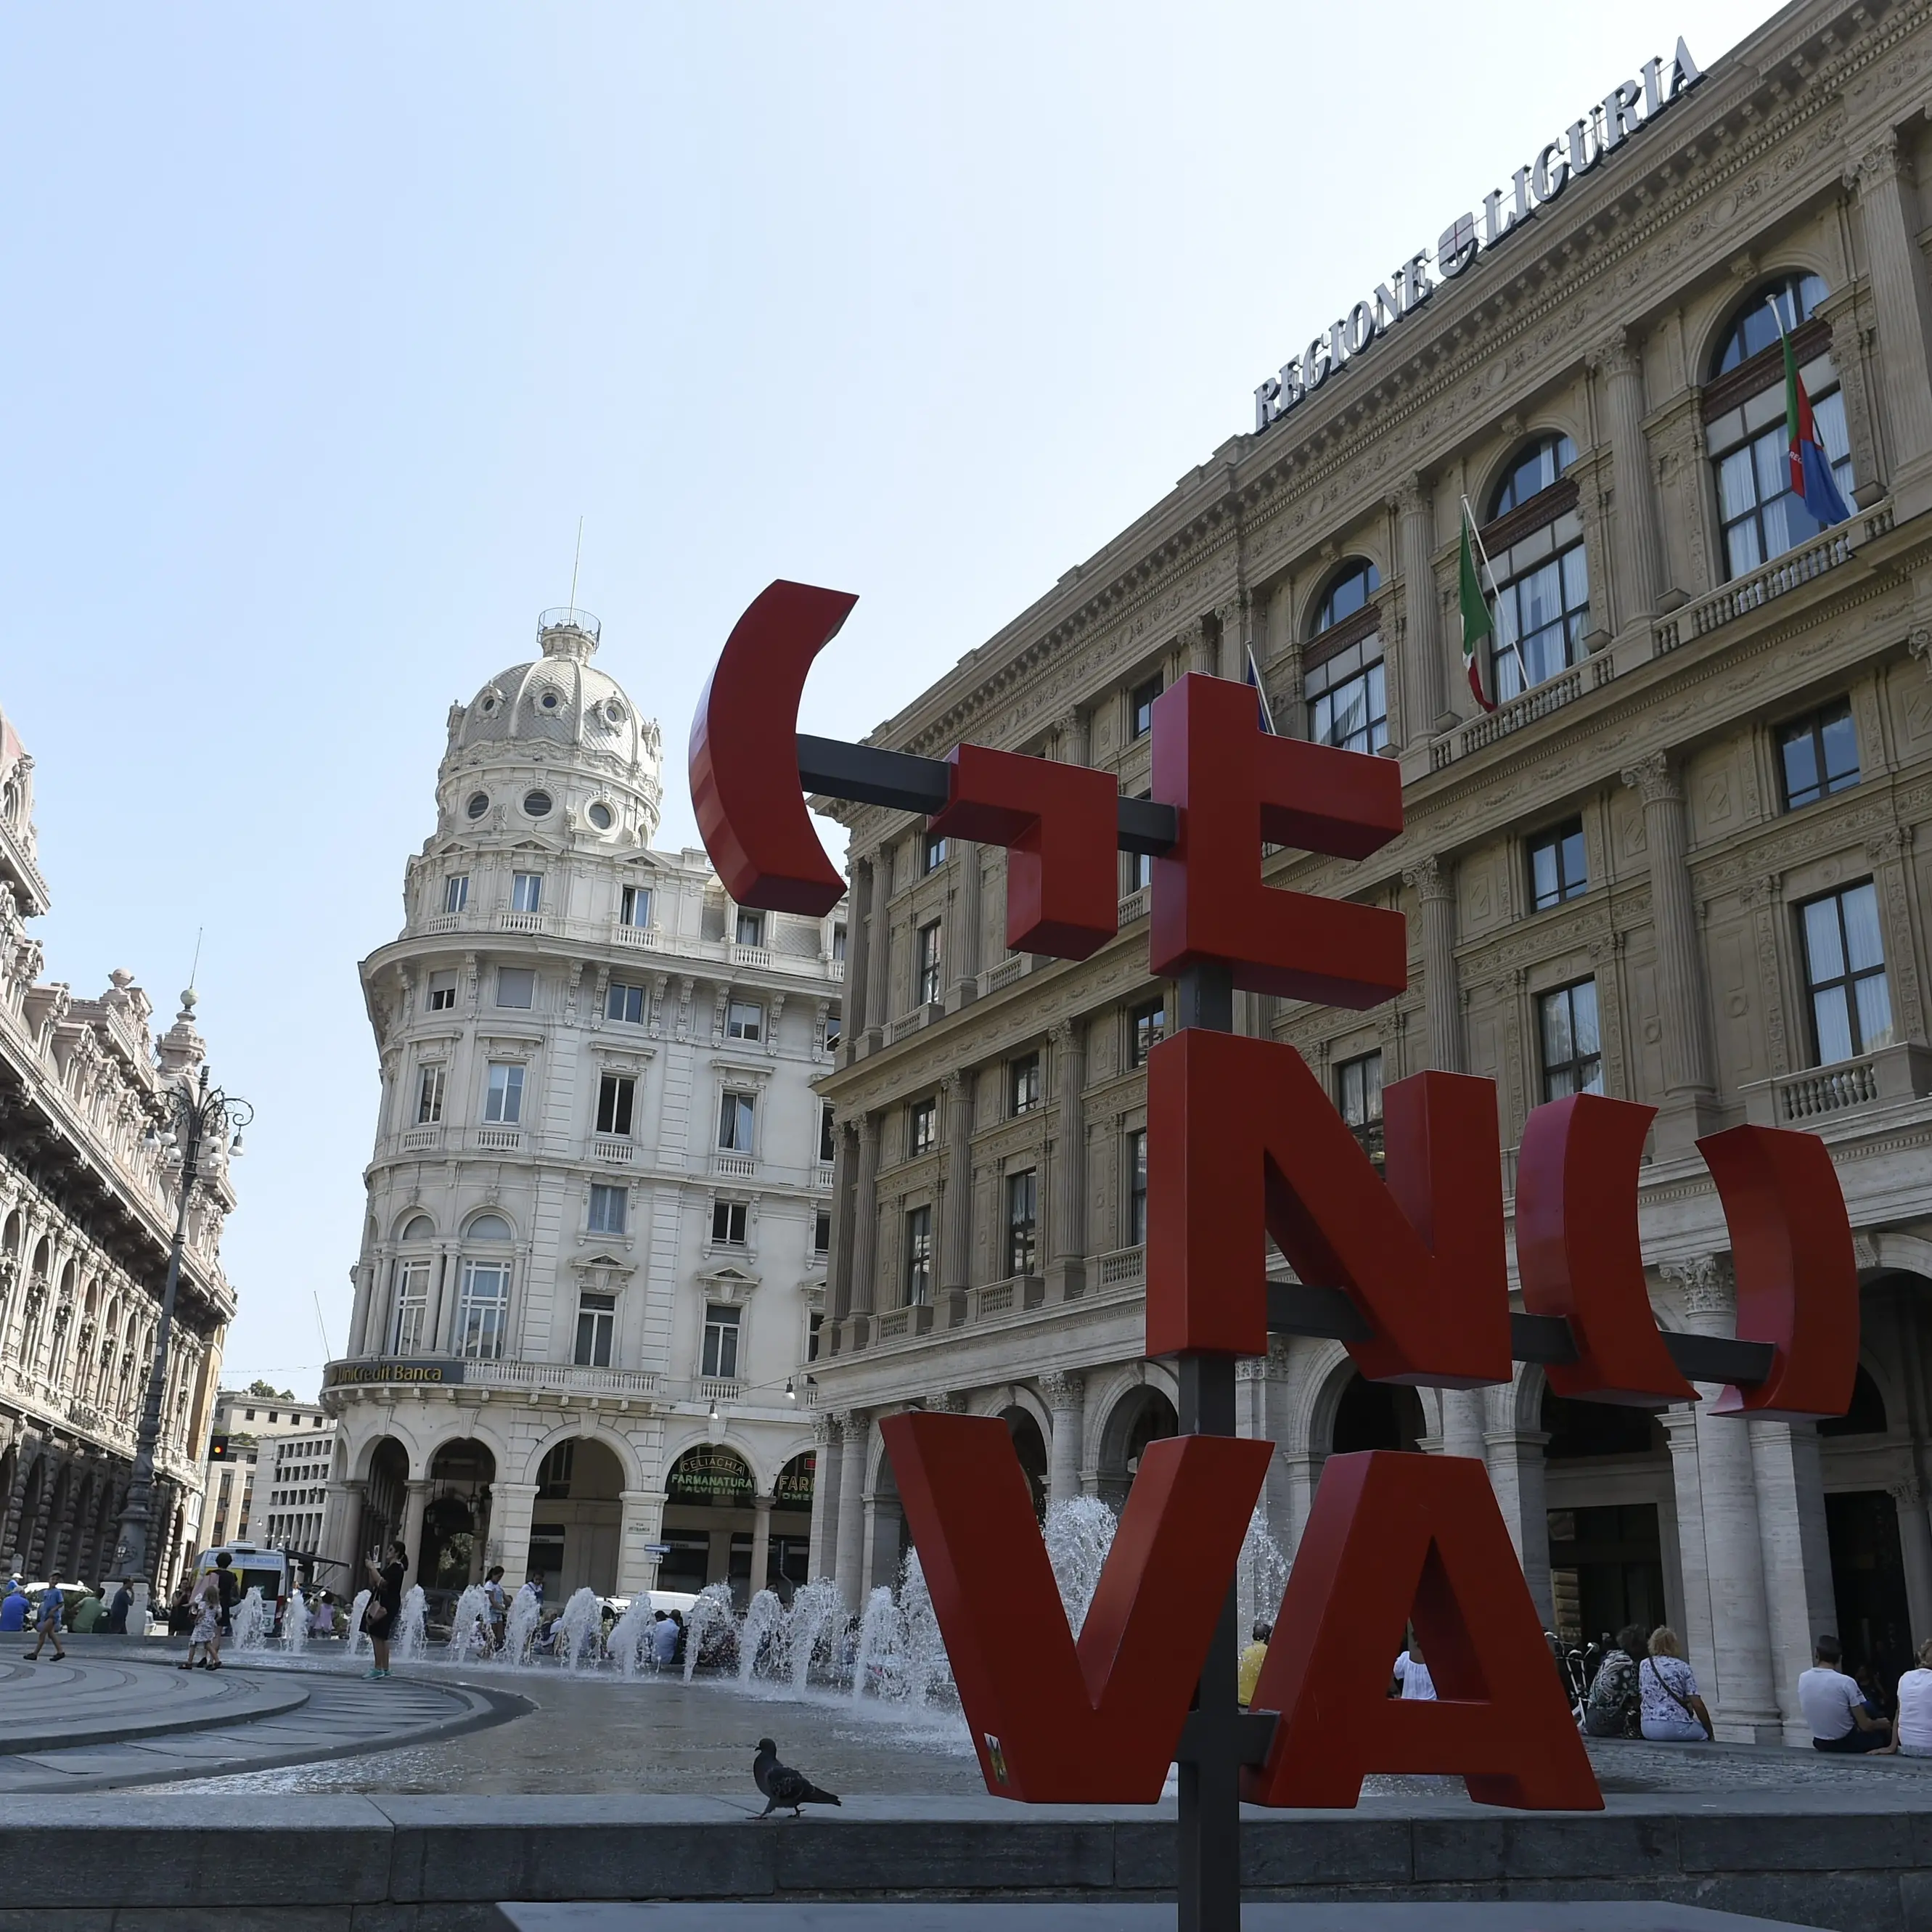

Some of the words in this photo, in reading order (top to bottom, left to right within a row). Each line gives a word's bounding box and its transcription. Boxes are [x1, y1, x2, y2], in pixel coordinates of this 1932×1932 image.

[1253, 248, 1434, 434] REGIONE
[1483, 35, 1706, 250] LIGURIA
[337, 1364, 390, 1382] UniCredit
[394, 1364, 442, 1381] Banca
[682, 1457, 743, 1473] CELIACHIA
[671, 1474, 753, 1489] FARMANATURA
